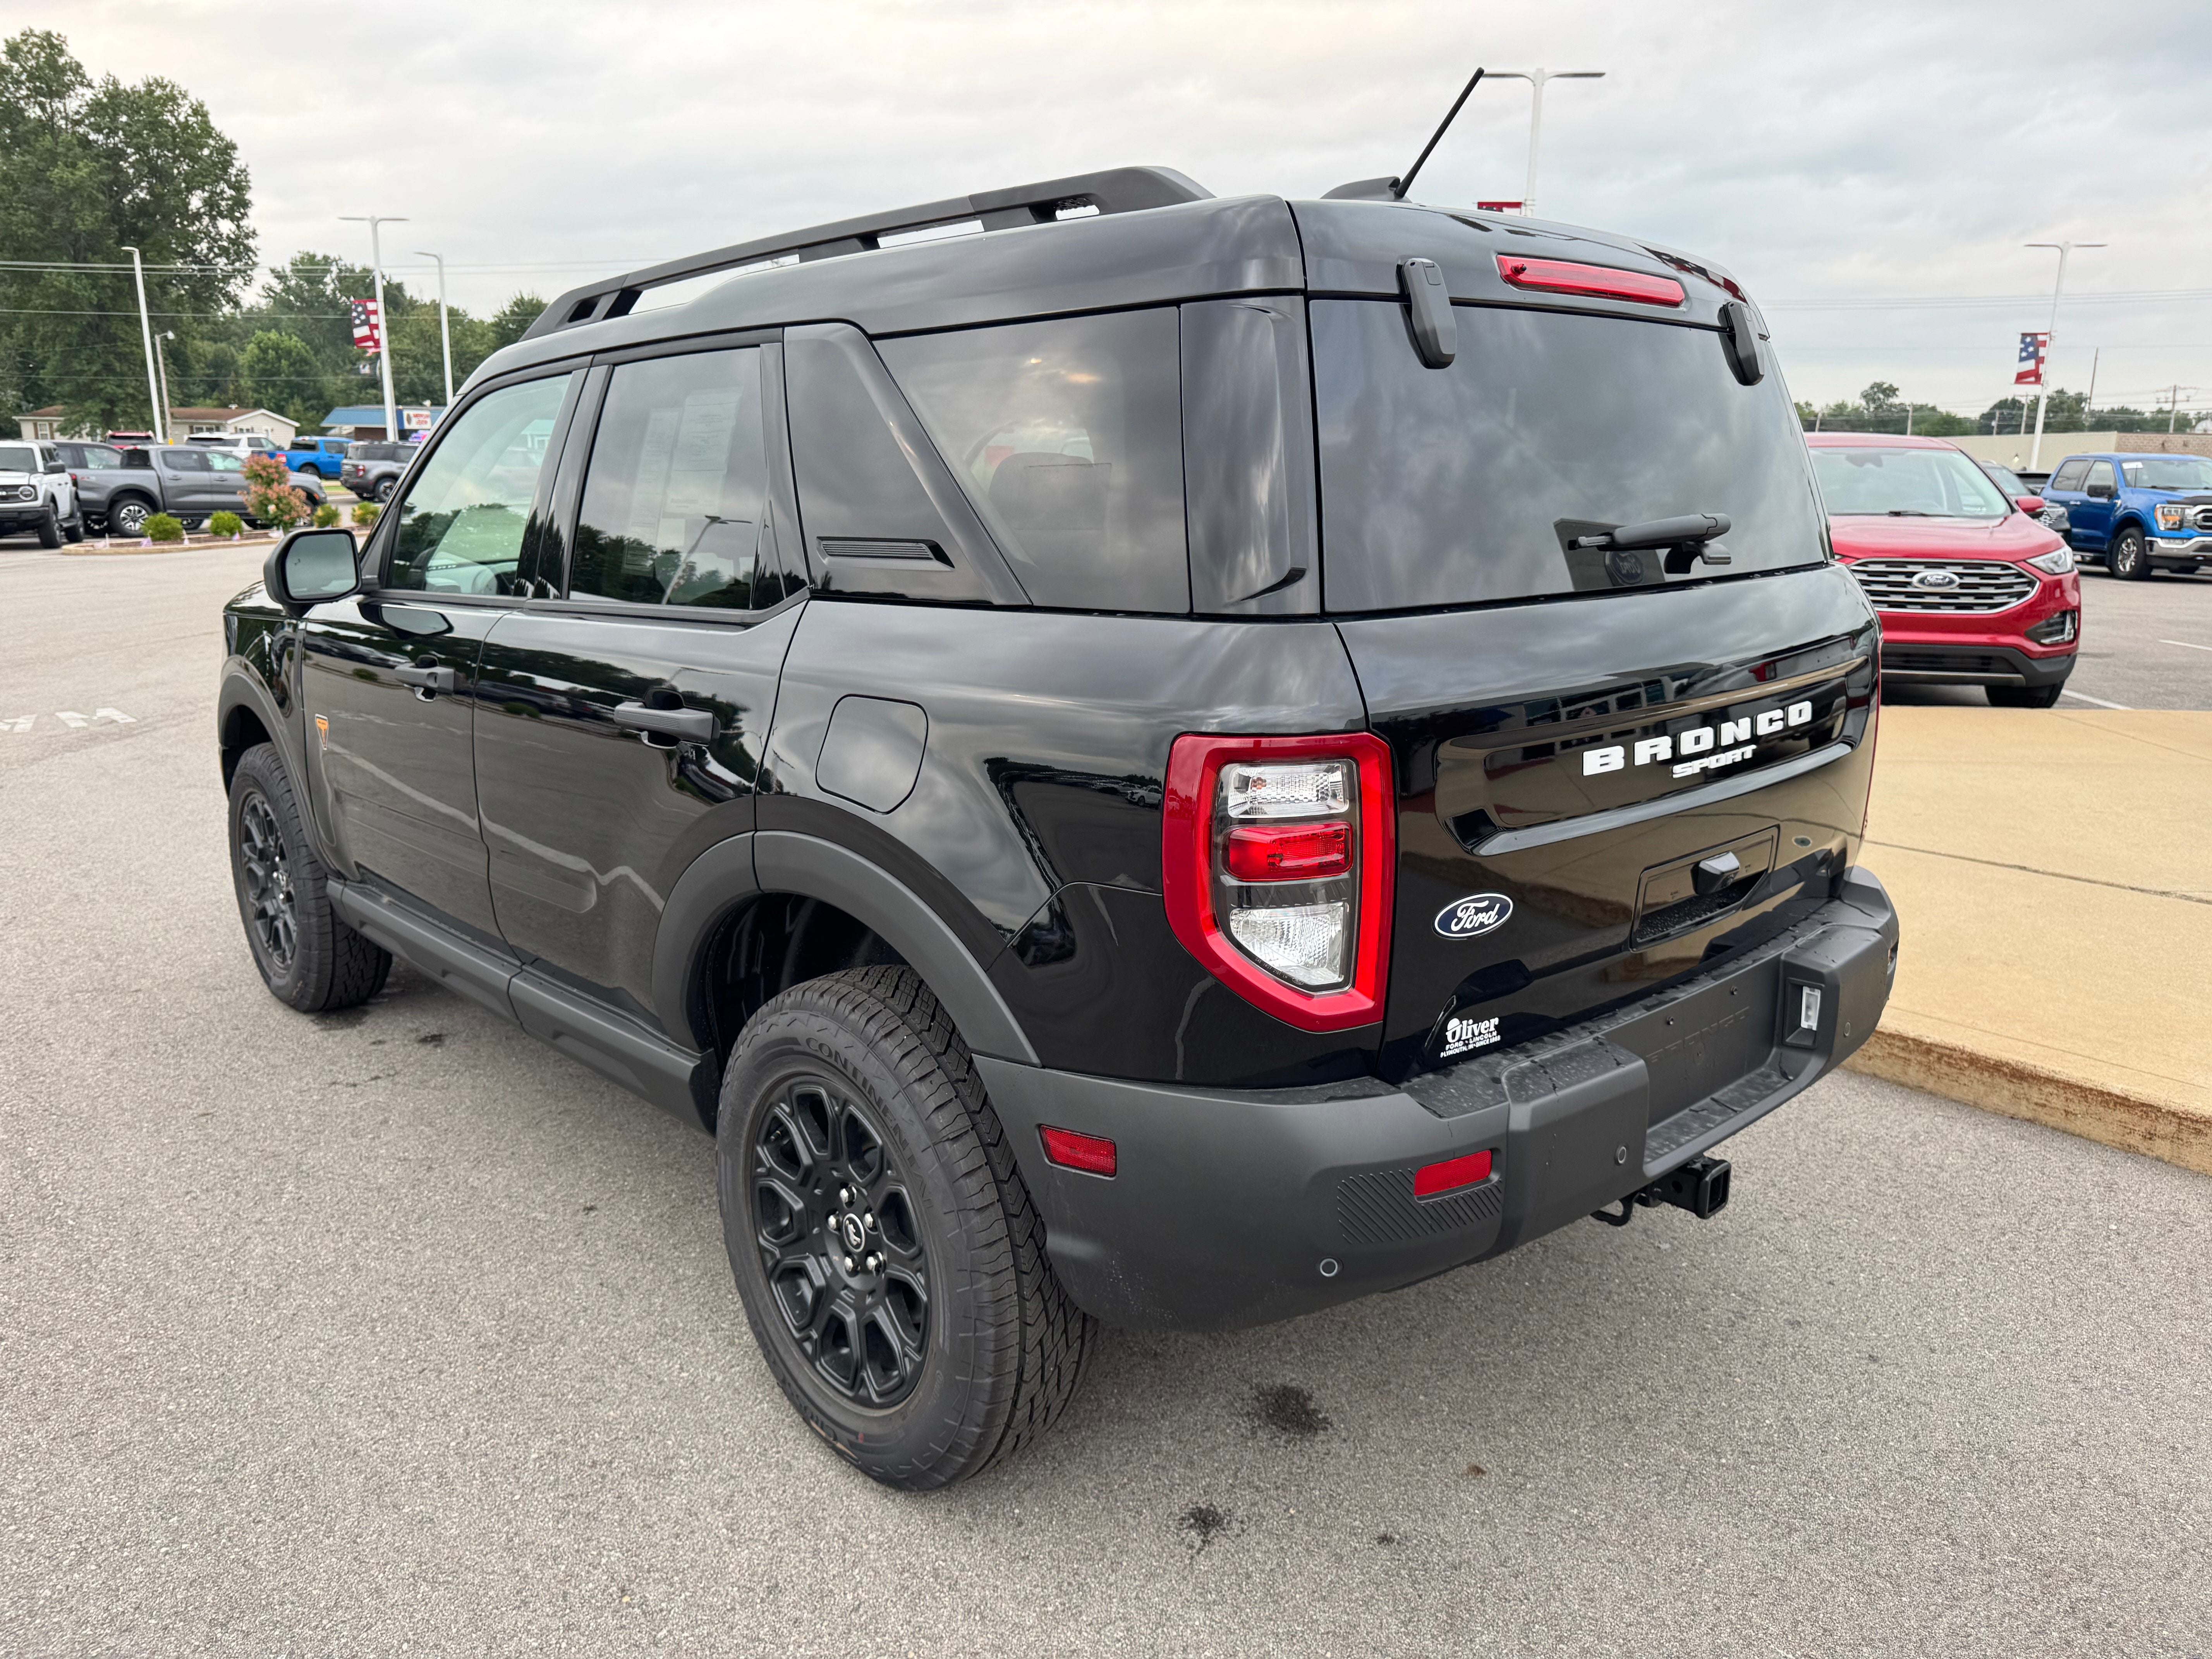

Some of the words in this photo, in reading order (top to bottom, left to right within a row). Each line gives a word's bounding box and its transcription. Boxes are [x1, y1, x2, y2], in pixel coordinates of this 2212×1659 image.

[1924, 575, 1949, 585] Ford
[1583, 701, 1812, 776] BRONCO
[1672, 744, 1757, 778] SPORT
[1451, 900, 1500, 932] Ford
[1445, 1041, 1464, 1051] FORD
[1469, 1030, 1498, 1044] LINCOLN
[1446, 1017, 1499, 1043] Oliver
[805, 1037, 934, 1208] CONTINENTAL
